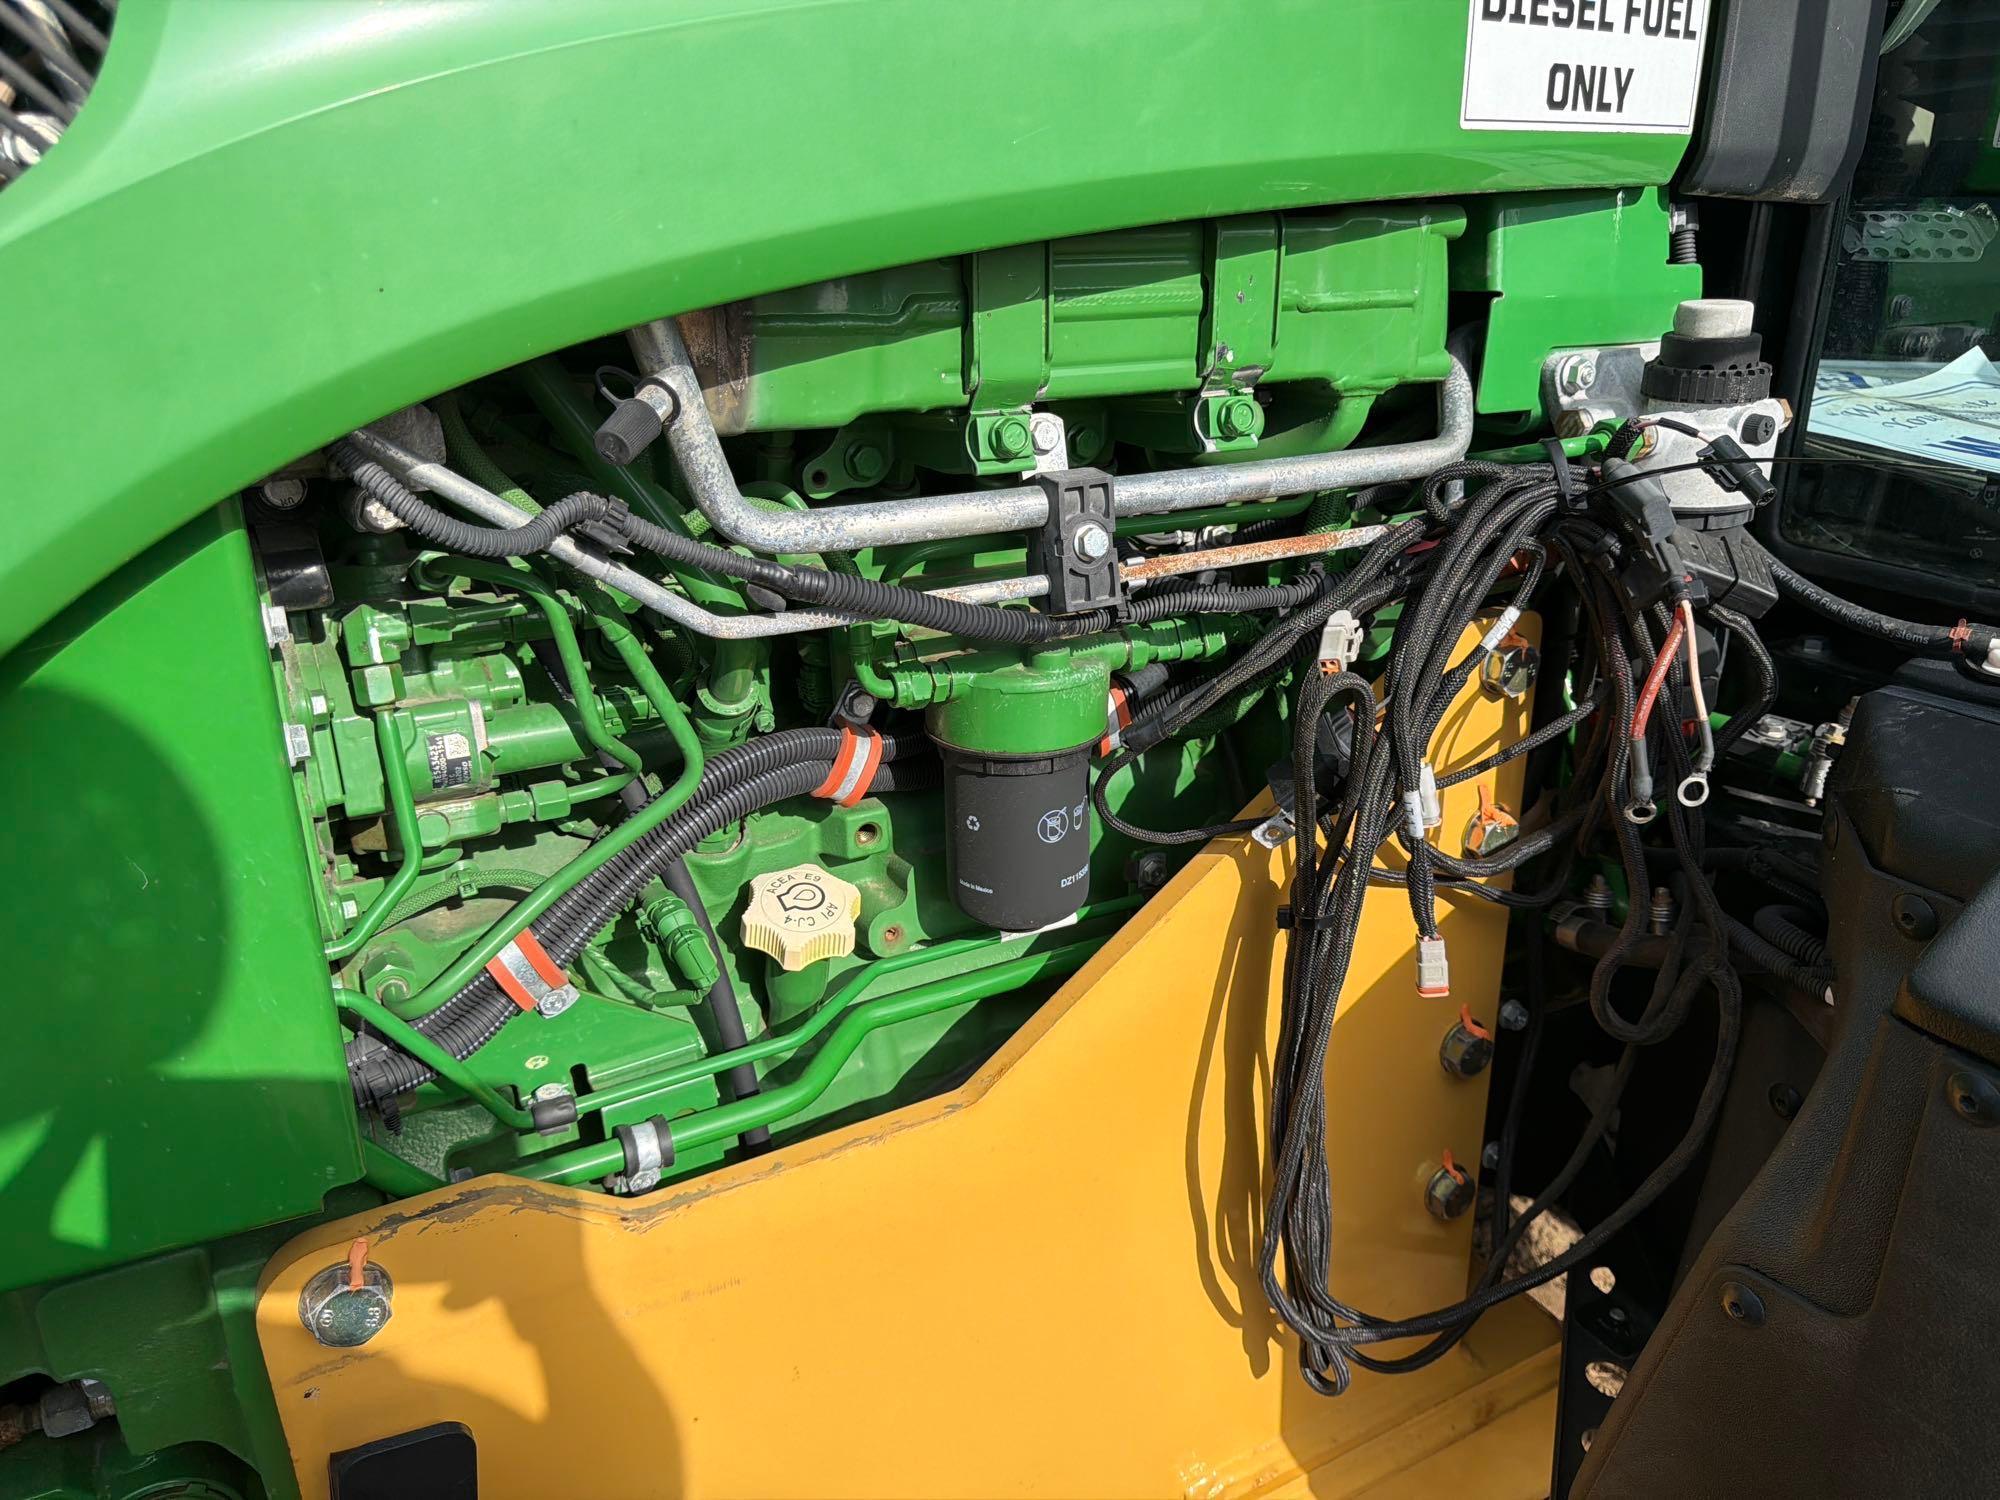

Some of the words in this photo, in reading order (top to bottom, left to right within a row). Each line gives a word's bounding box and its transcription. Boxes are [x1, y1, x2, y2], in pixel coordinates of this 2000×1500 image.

[1624, 0, 1697, 40] FUEL
[1546, 63, 1634, 113] ONLY
[1803, 587, 1821, 602] For
[1820, 597, 1842, 613] Fuel
[1841, 606, 1881, 631] Injection
[766, 874, 796, 895] ACEA
[804, 873, 822, 882] E9
[783, 914, 816, 928] CJ-4
[820, 902, 839, 920] API
